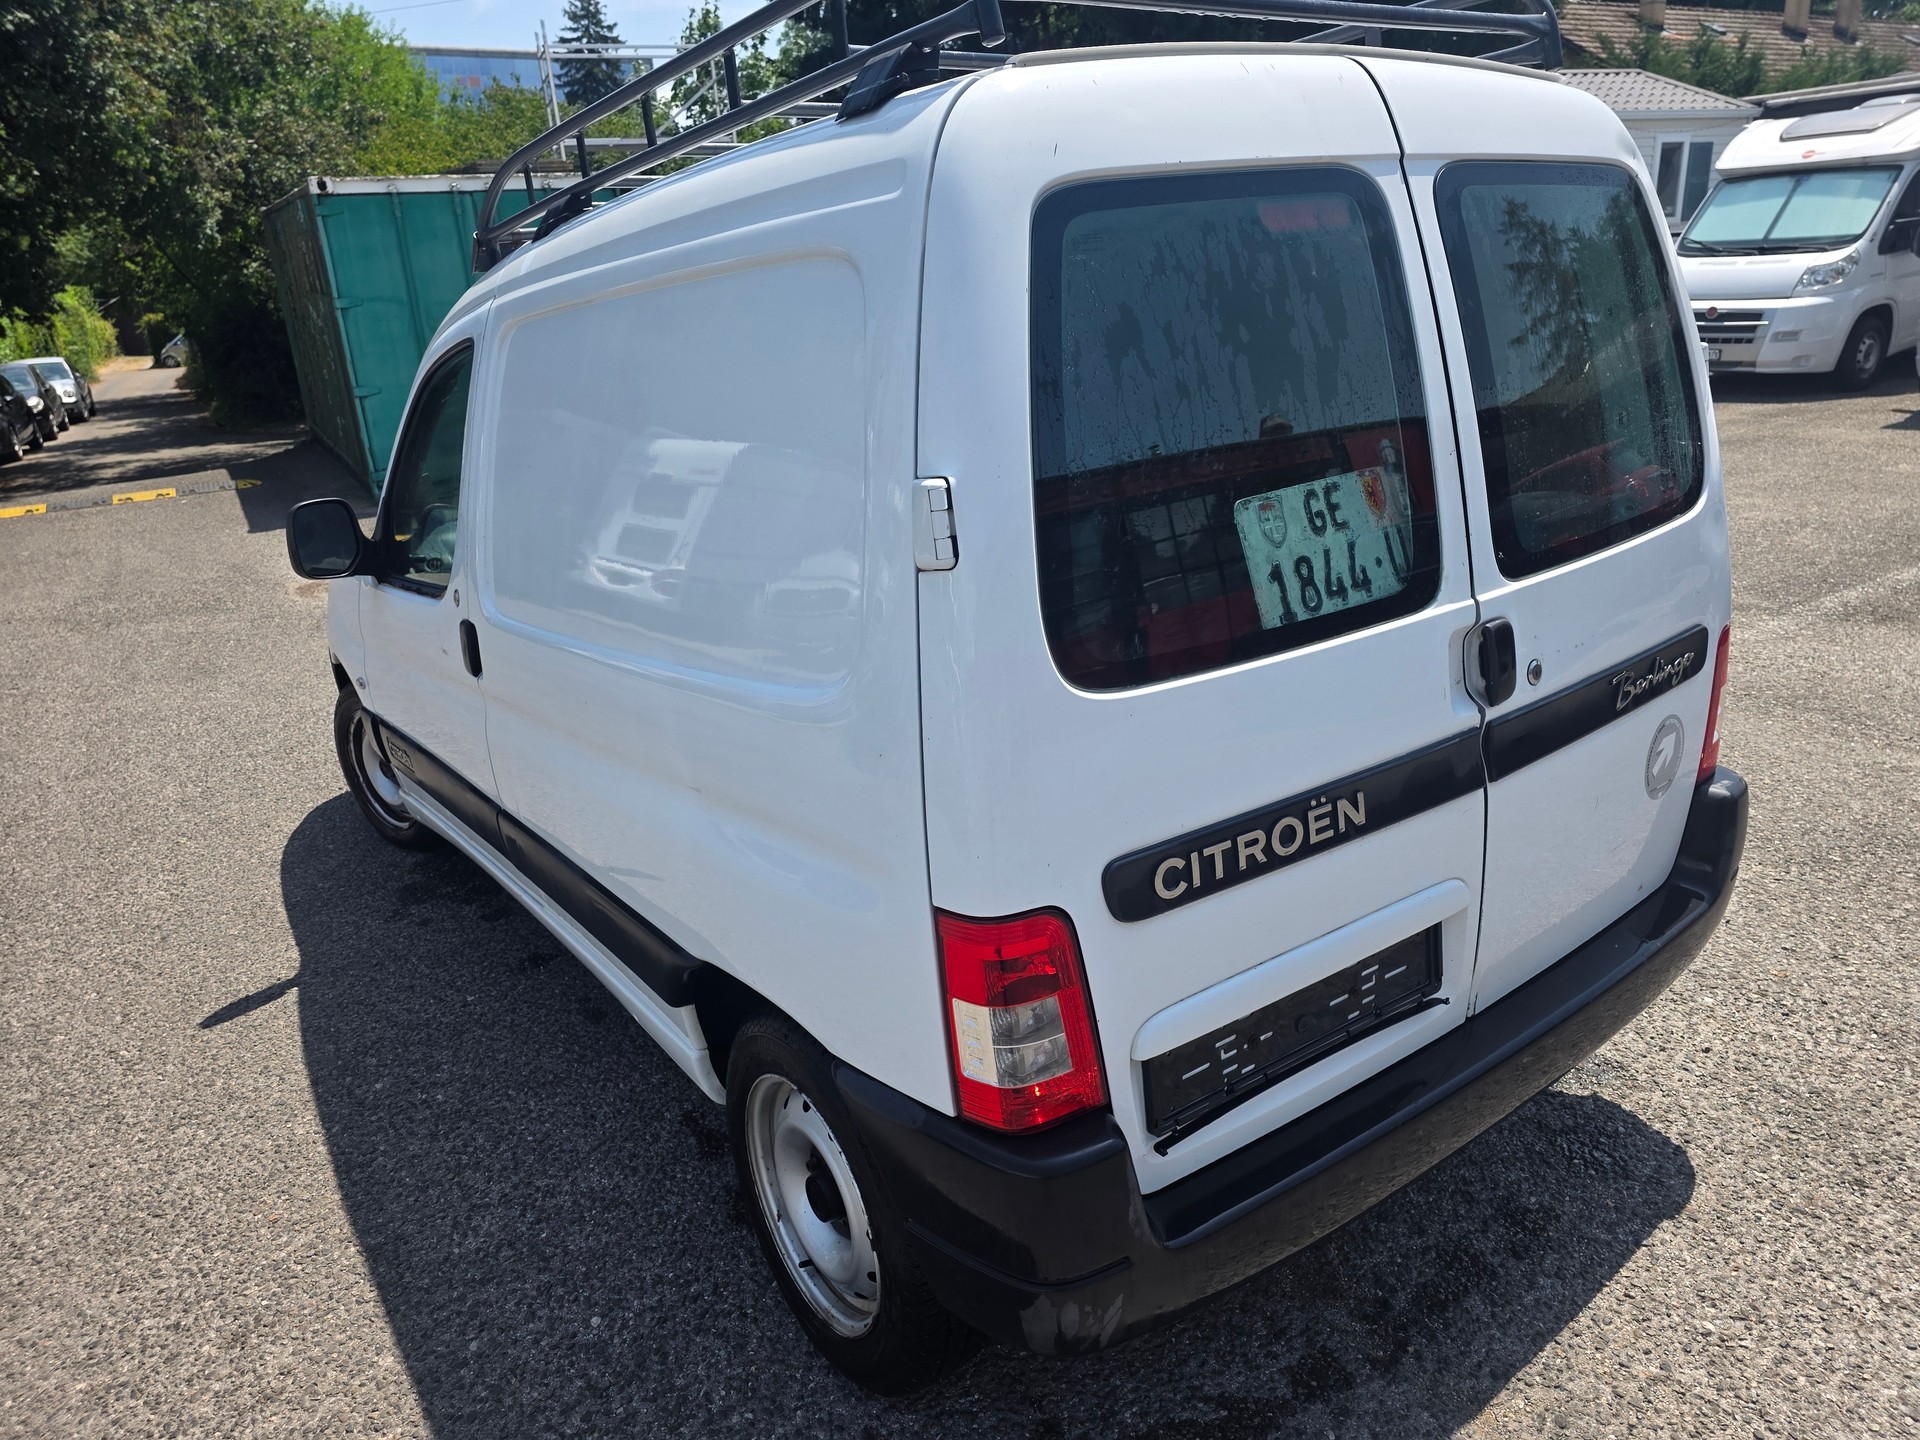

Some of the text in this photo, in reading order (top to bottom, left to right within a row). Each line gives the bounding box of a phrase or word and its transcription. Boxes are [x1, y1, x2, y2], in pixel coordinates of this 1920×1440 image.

[1303, 481, 1350, 537] GE
[1612, 652, 1695, 711] Berlingo
[1154, 791, 1367, 900] CITROËN
